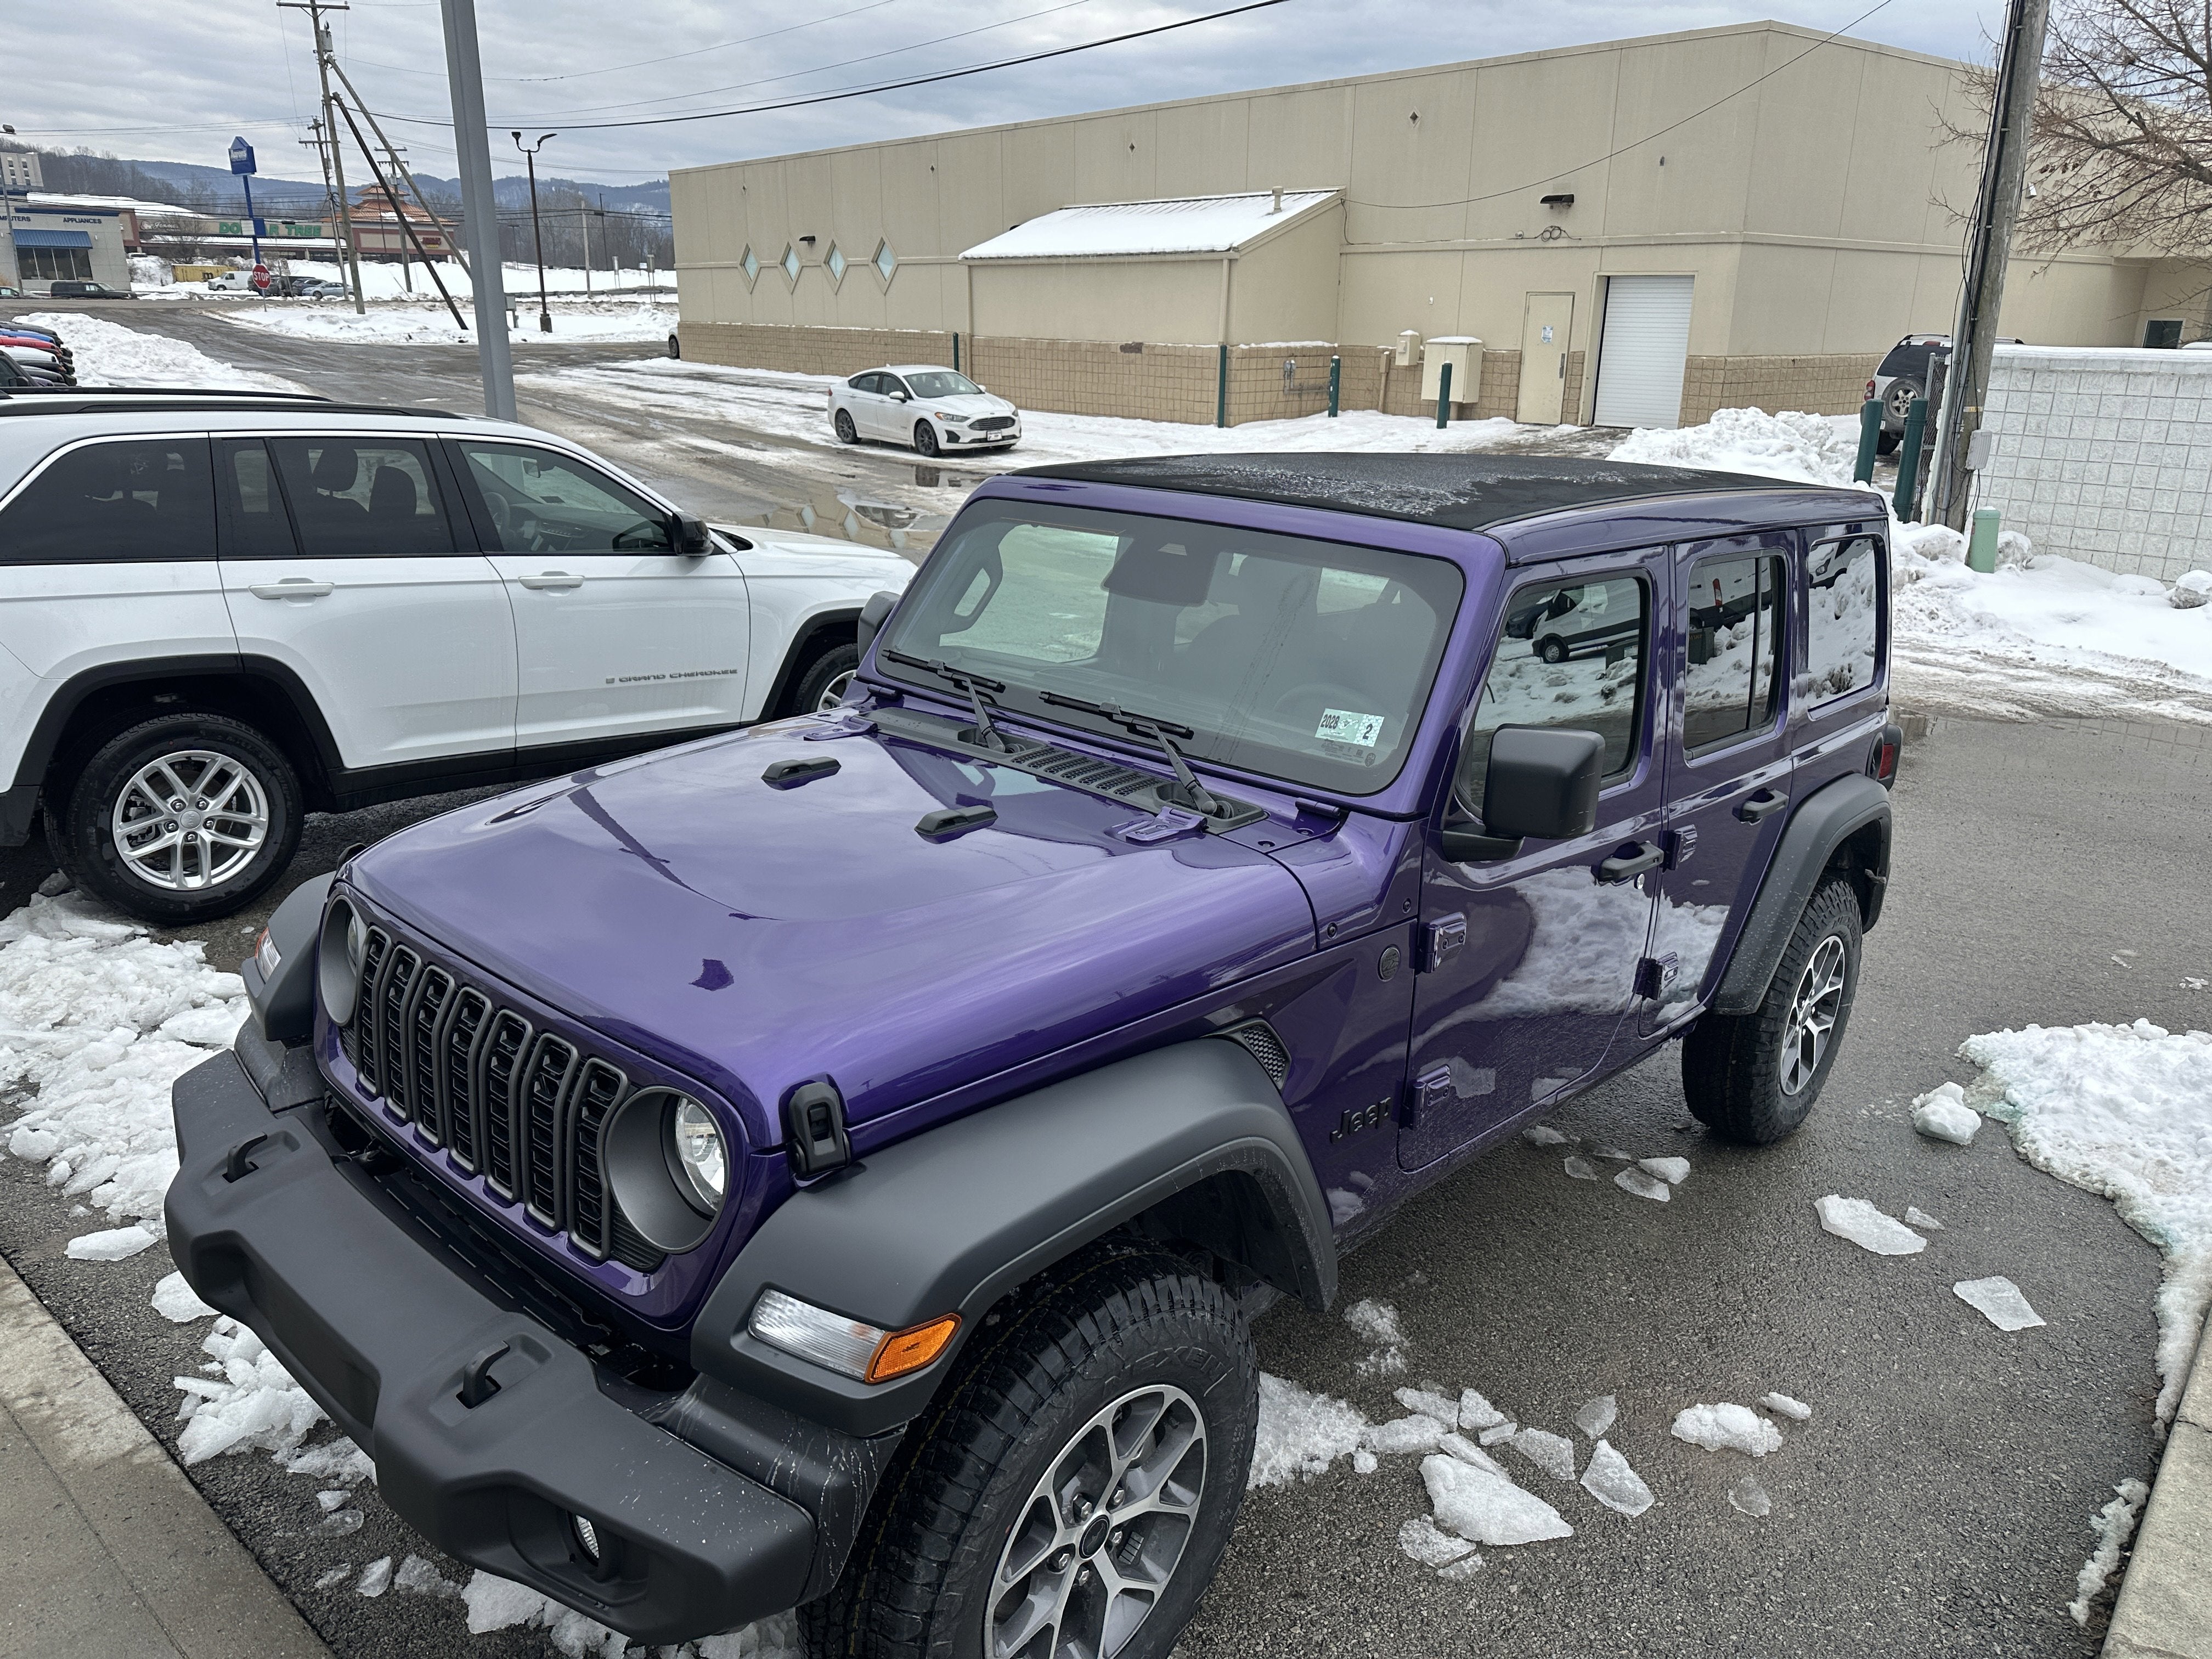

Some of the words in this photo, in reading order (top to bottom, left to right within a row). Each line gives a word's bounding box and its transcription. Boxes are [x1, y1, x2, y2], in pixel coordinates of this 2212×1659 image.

[219, 222, 279, 235] DOR
[285, 225, 321, 236] TREE
[254, 271, 269, 281] STOP
[619, 674, 666, 682] GRAND
[669, 669, 737, 679] CHEROKEE
[1320, 714, 1340, 730] 2028
[1362, 723, 1373, 740] 2
[1329, 1097, 1392, 1145] Jeep
